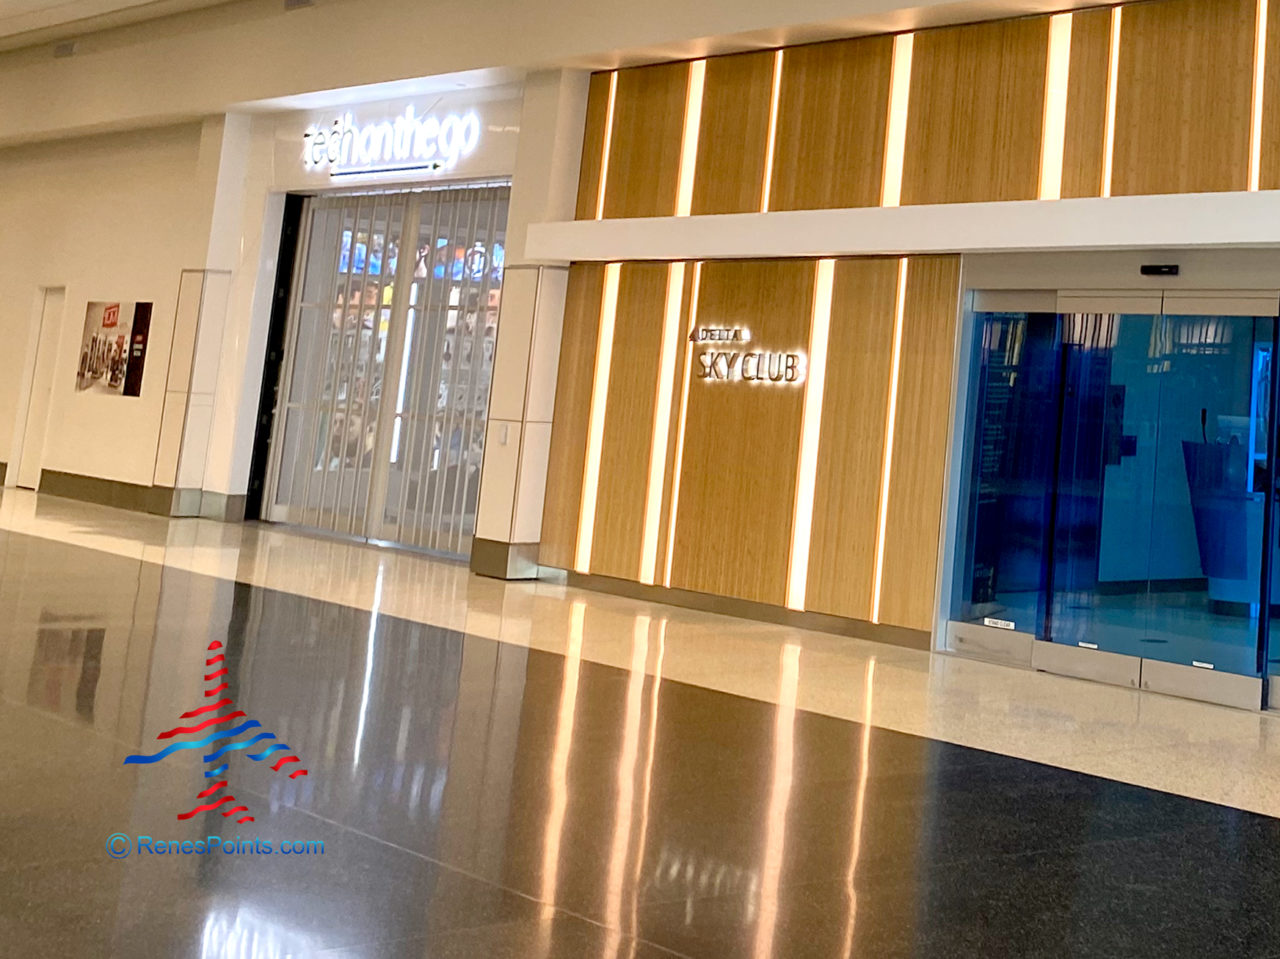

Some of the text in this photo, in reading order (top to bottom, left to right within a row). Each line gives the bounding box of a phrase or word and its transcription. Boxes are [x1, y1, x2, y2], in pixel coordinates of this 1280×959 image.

[699, 328, 743, 341] DELTA
[697, 352, 800, 382] SKY CLUB
